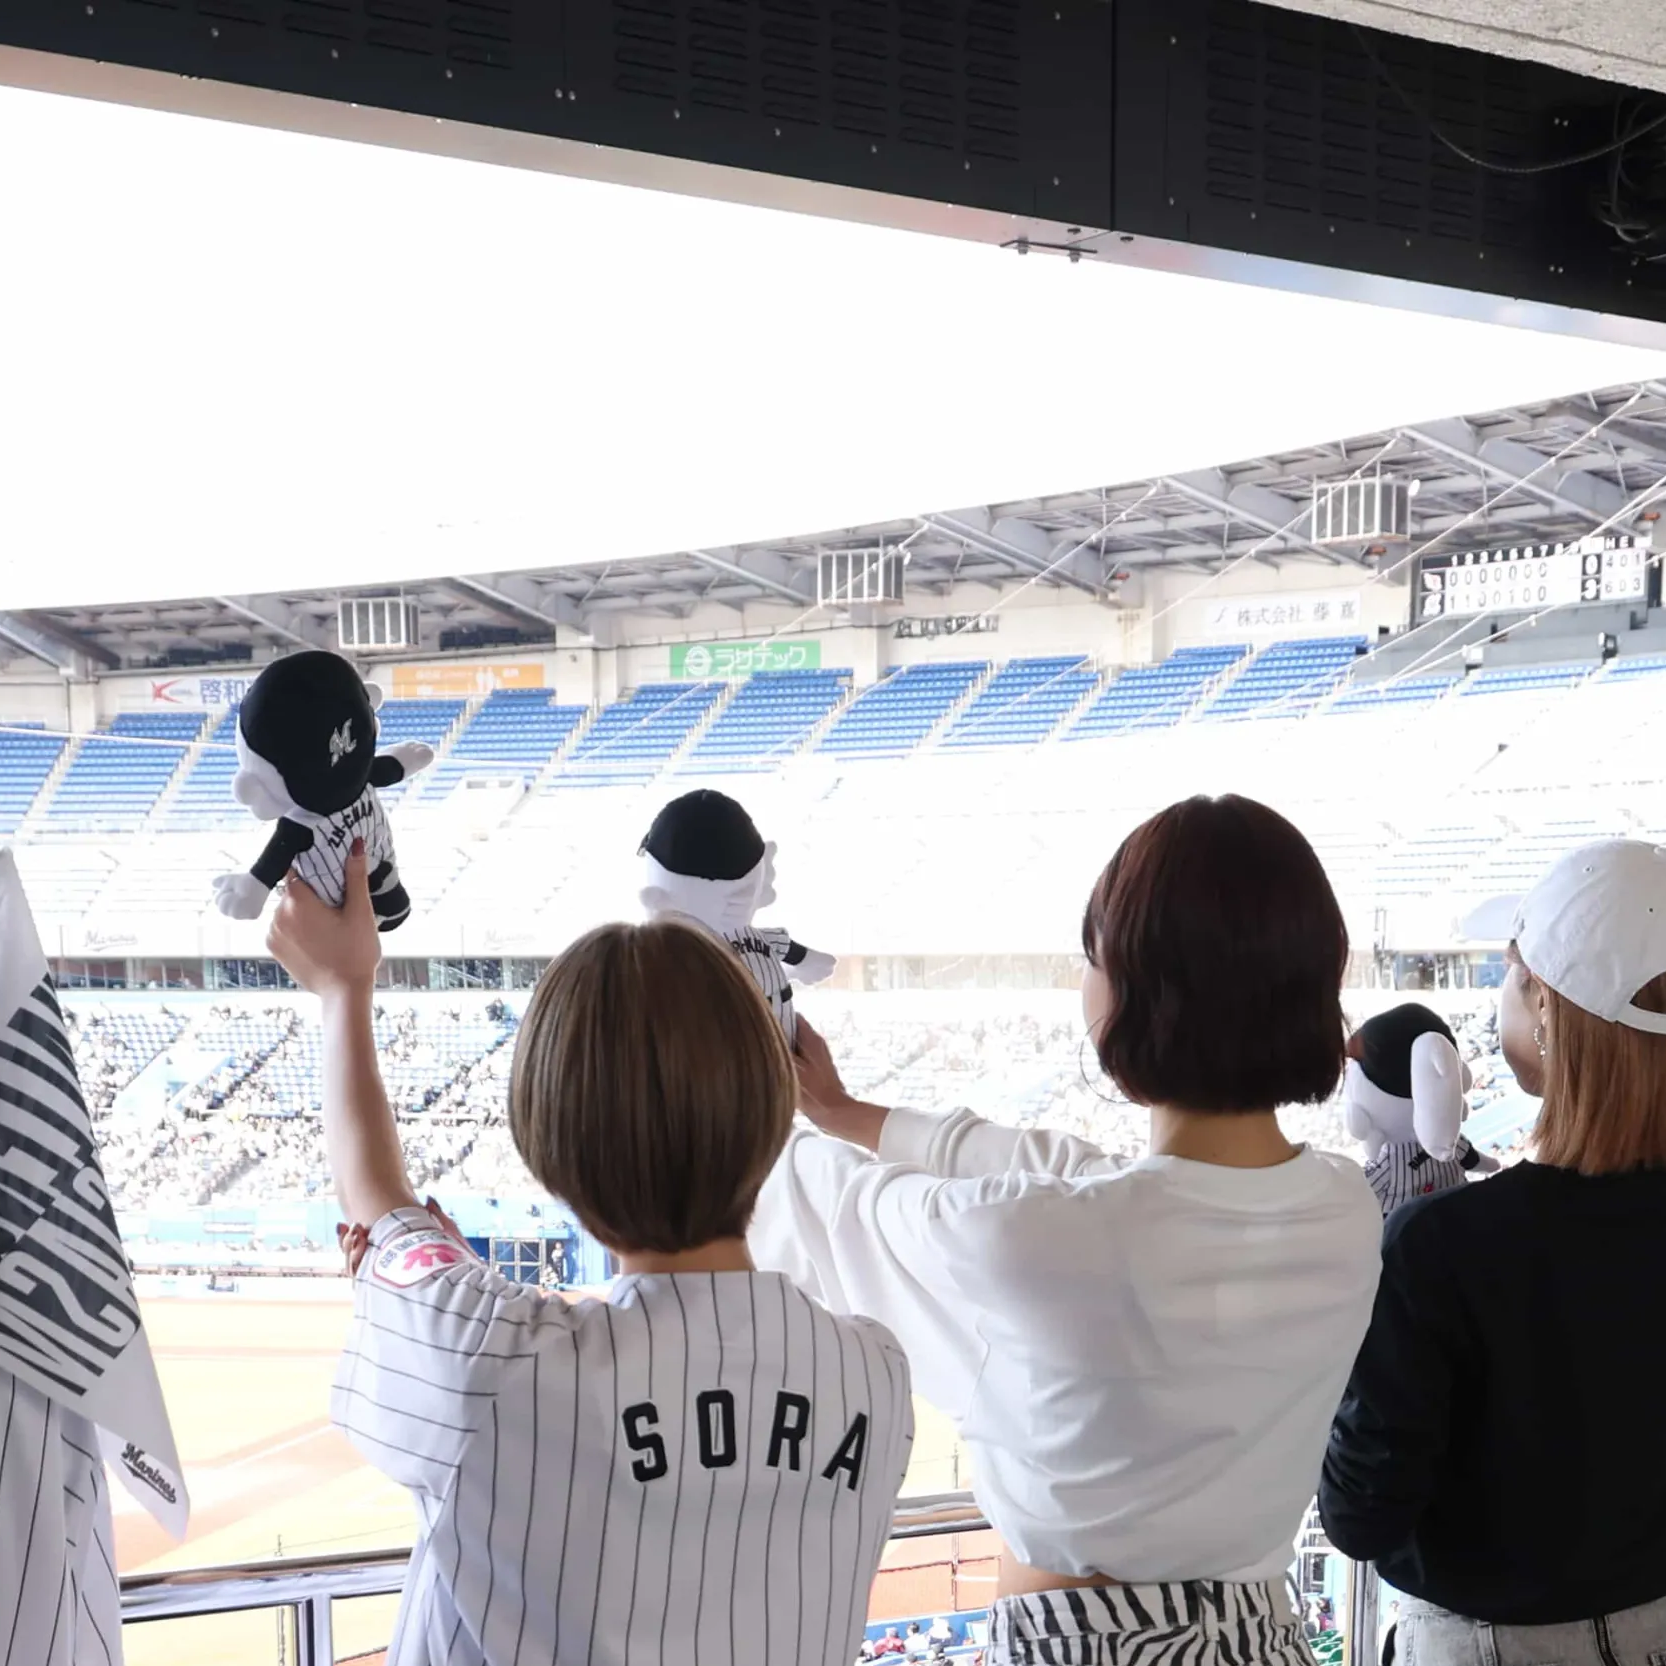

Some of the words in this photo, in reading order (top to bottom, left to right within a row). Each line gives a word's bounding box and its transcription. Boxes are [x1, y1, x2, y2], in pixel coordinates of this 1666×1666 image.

[329, 718, 358, 768] M
[621, 1388, 869, 1492] SORA
[120, 1441, 178, 1504] Marines
